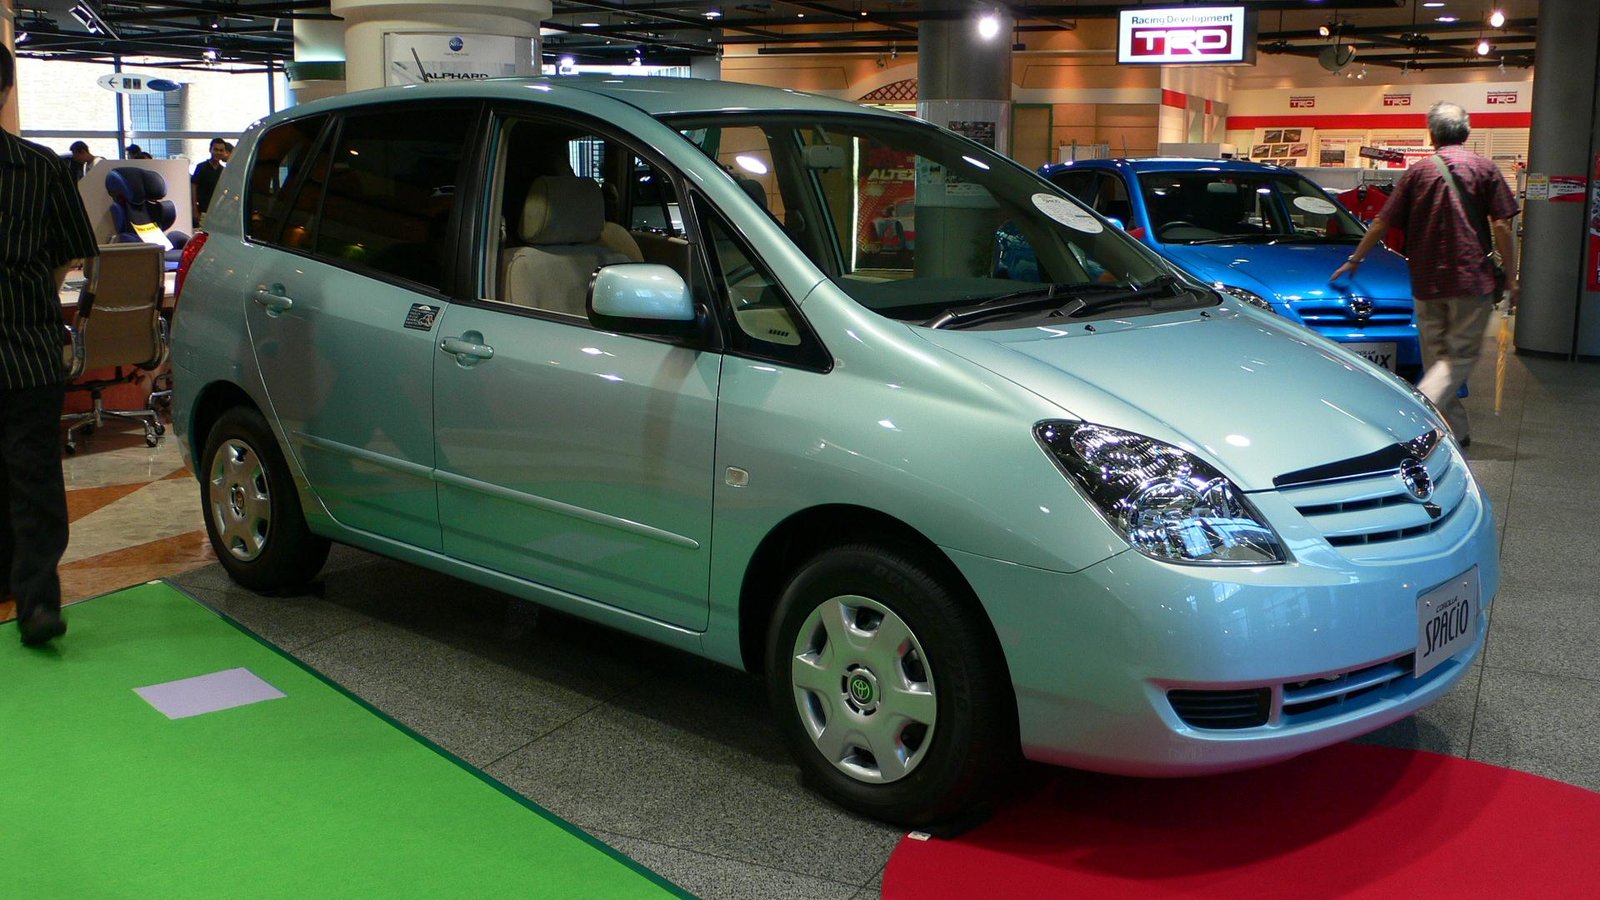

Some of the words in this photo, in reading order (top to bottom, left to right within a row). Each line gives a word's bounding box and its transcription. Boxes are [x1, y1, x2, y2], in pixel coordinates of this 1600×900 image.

[1131, 16, 1165, 25] Racing
[1166, 13, 1233, 24] Development
[1132, 27, 1230, 55] TRD
[1290, 99, 1315, 107] TRD
[1384, 97, 1411, 106] TRD
[1487, 95, 1517, 104] TRD
[868, 169, 915, 180] ALTEZ
[1364, 354, 1391, 369] NX
[1436, 595, 1458, 613] COROLLA
